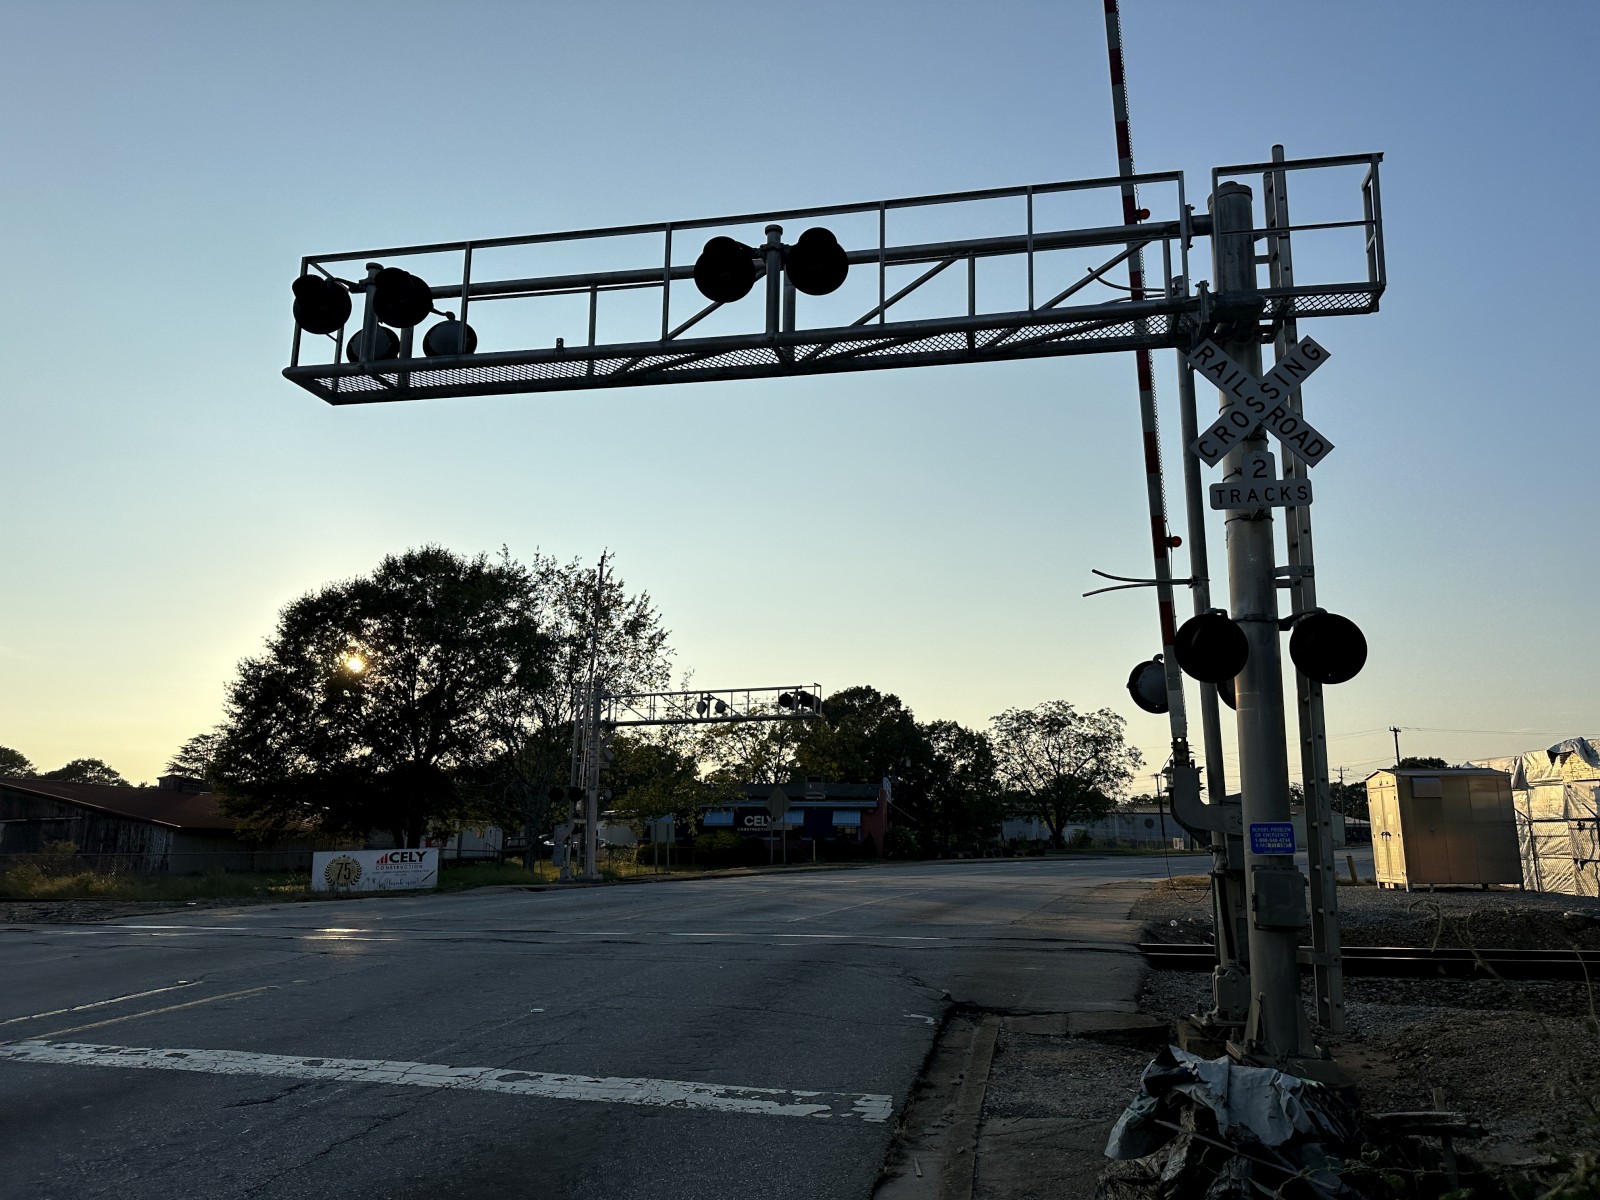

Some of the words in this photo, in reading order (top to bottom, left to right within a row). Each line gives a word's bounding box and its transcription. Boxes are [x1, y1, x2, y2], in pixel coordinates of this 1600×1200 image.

[1198, 343, 1321, 458] CROSSING
[1252, 459, 1267, 479] 2
[1215, 485, 1309, 504] TRACKS
[389, 851, 427, 863] CELY
[336, 862, 351, 880] 75
